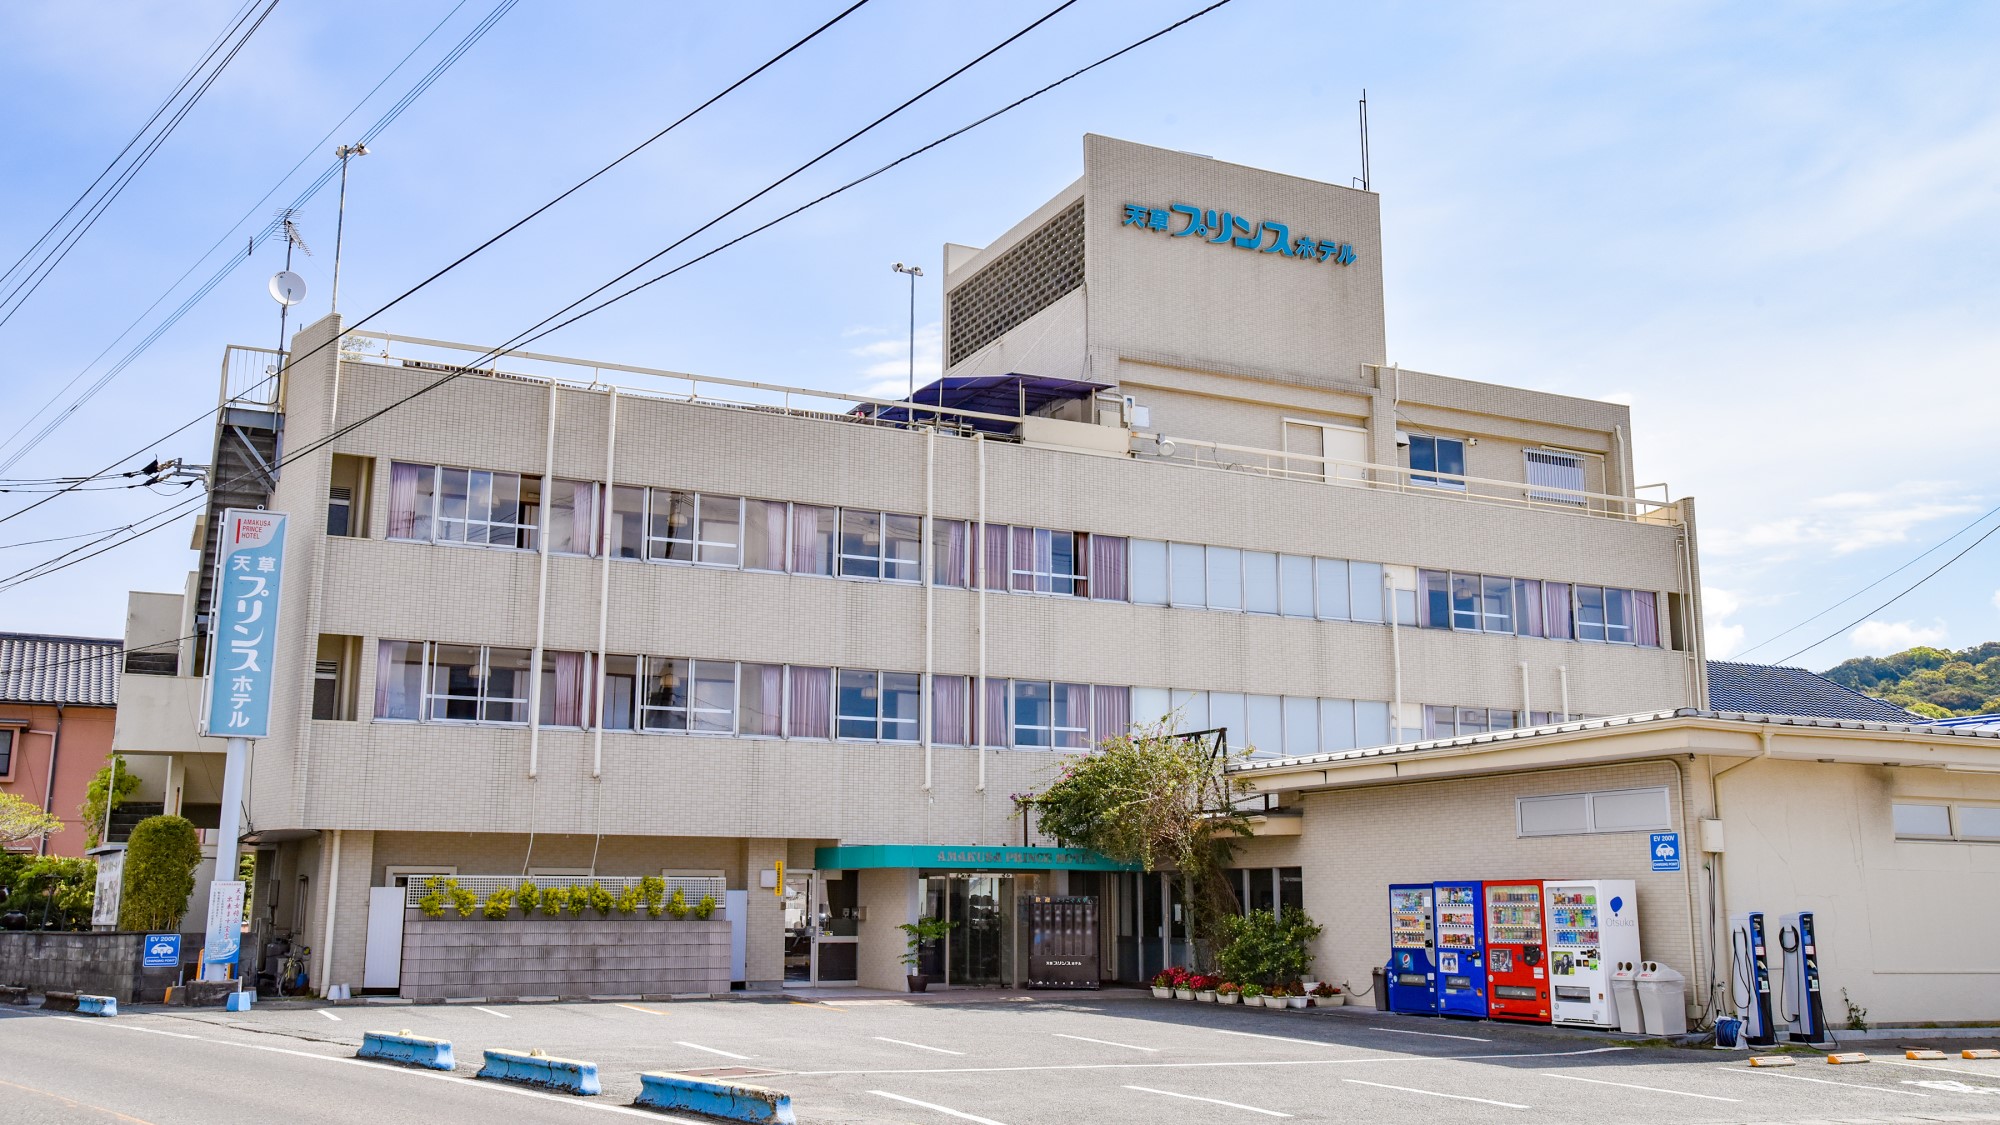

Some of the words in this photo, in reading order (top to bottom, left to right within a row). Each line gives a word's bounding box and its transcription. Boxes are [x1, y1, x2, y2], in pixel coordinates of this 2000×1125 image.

[1123, 203, 1357, 266] 天草プリンスホテル
[243, 519, 271, 527] AMAKUSA
[242, 525, 263, 533] PRINCE
[232, 555, 276, 573] 天草
[938, 851, 1003, 863] AMAKUSA
[1005, 852, 1052, 864] PRINCE
[1606, 918, 1634, 927] Otsuka
